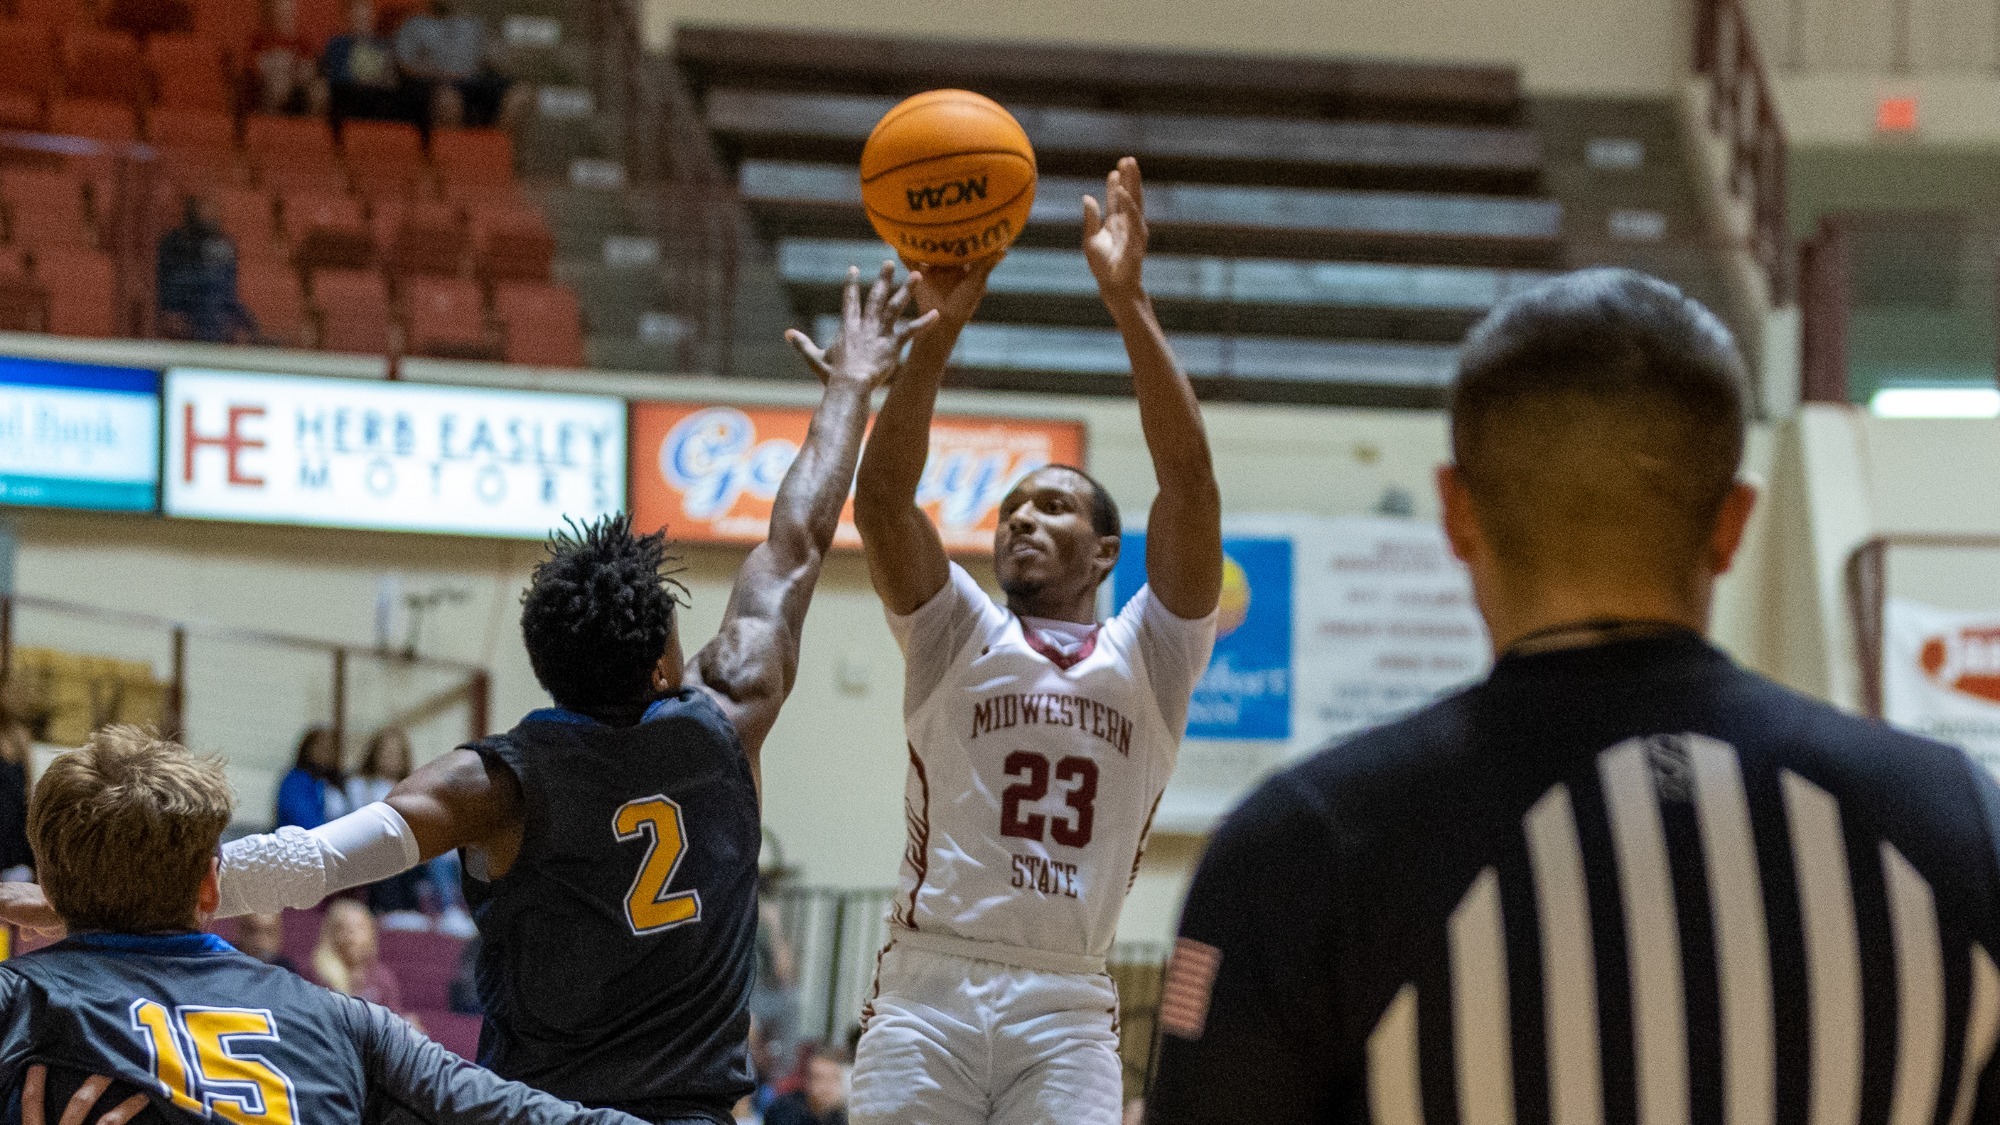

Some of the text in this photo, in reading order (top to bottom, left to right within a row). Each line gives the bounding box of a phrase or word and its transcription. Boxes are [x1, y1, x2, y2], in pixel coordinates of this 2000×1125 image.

[905, 175, 988, 212] NCAA
[900, 217, 1011, 257] Wilson
[296, 407, 416, 457] HERB
[439, 412, 613, 469] EASLEY
[300, 456, 611, 511] MOTORS
[971, 693, 1134, 757] MIDWESTERN
[1000, 750, 1100, 848] 23
[612, 794, 702, 935] 2
[1011, 853, 1079, 899] STATE
[129, 997, 302, 1125] 15
